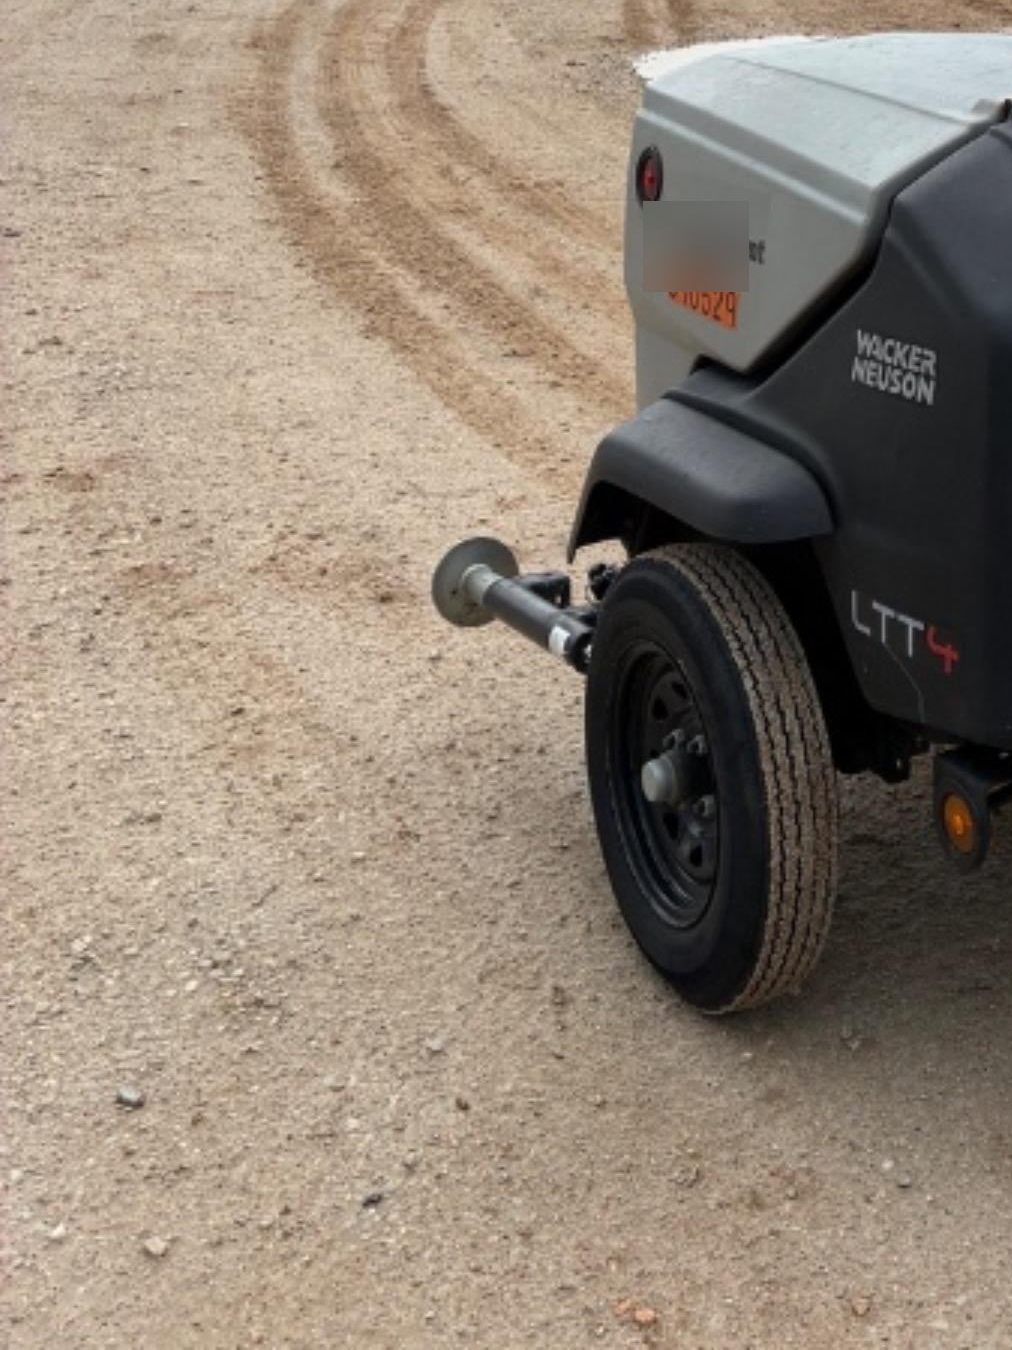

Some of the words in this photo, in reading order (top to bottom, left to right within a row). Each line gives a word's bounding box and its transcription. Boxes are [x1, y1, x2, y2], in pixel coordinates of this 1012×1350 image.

[857, 329, 937, 378] WACKER
[851, 356, 936, 406] NEUSON
[850, 589, 960, 674] LTT4
